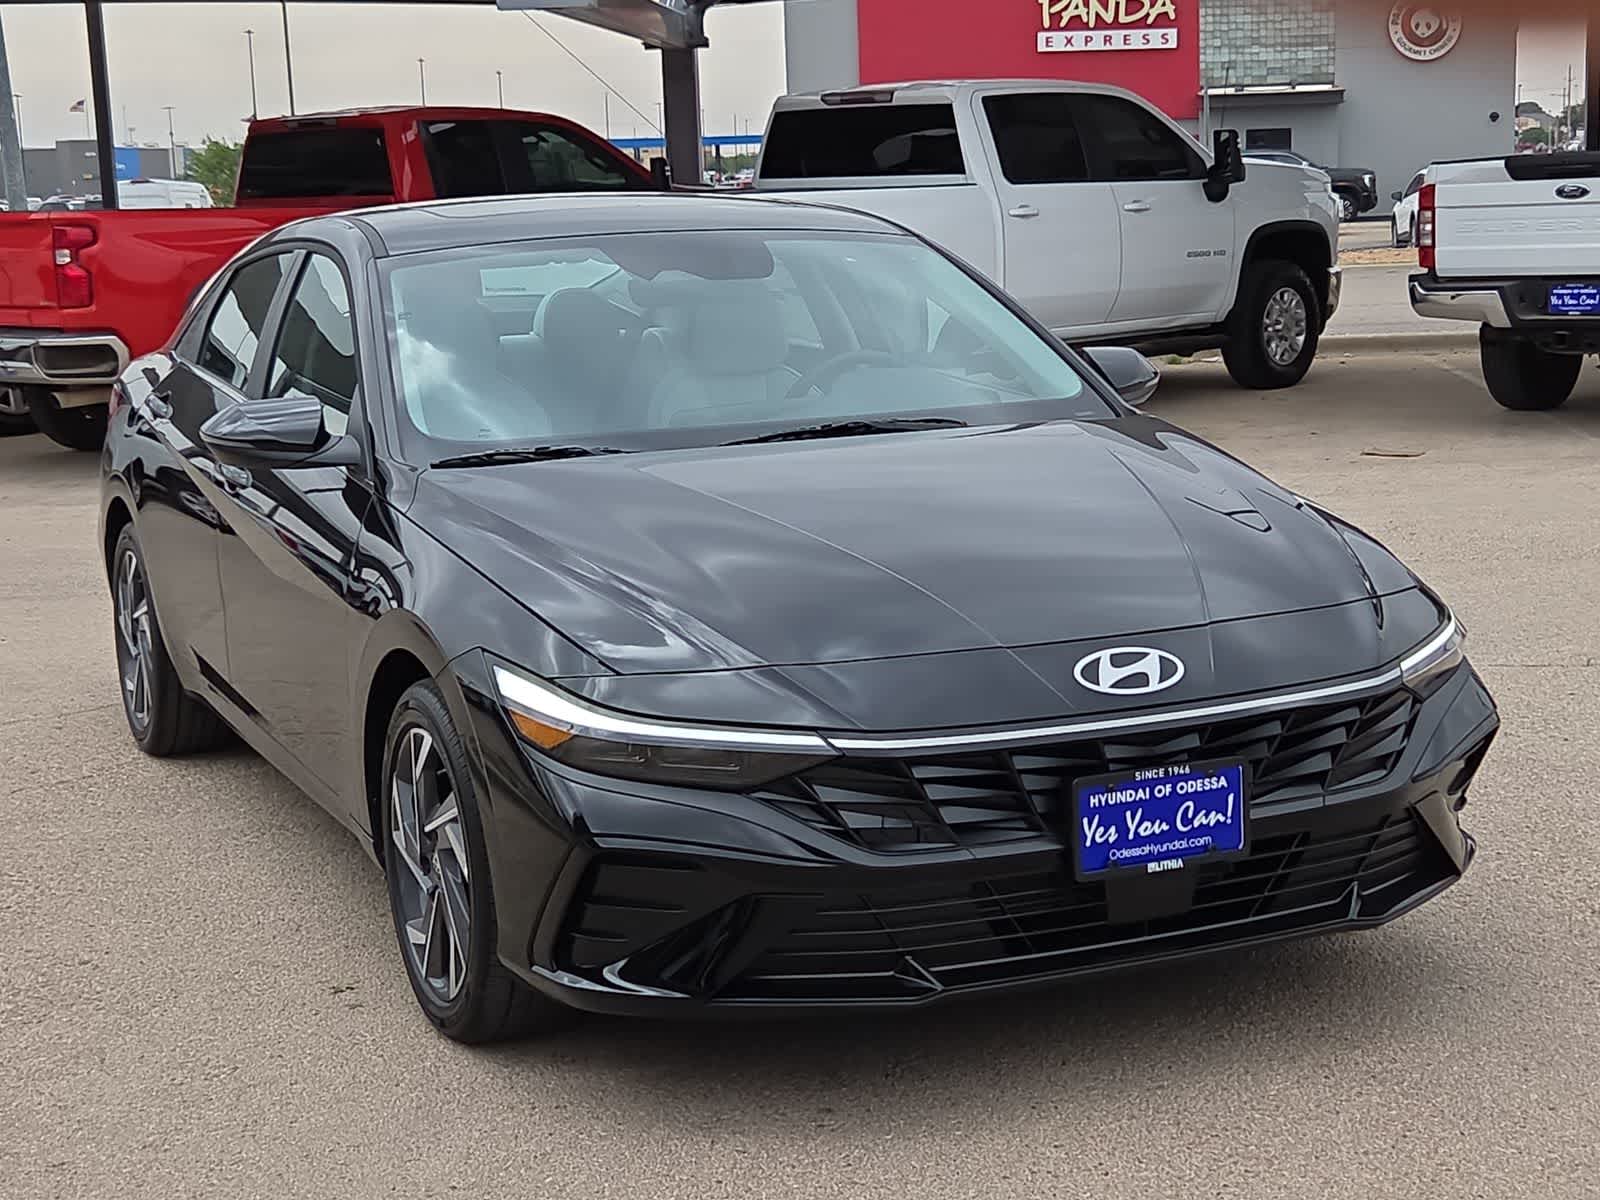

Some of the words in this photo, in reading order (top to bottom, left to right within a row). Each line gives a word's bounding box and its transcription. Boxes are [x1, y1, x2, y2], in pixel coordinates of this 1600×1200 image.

[1038, 0, 1176, 28] PANDA
[1045, 33, 1170, 48] EXPRESS
[1135, 768, 1165, 781] SINCE
[1168, 765, 1191, 777] 1946
[1089, 787, 1150, 808] HYUNDAI
[1154, 785, 1173, 799] OF
[1176, 776, 1228, 794] ODESSA
[1082, 814, 1119, 848] Yes
[1125, 808, 1170, 840] You
[1175, 793, 1235, 833] Can!
[1109, 836, 1212, 860] OdessaHyundai.com
